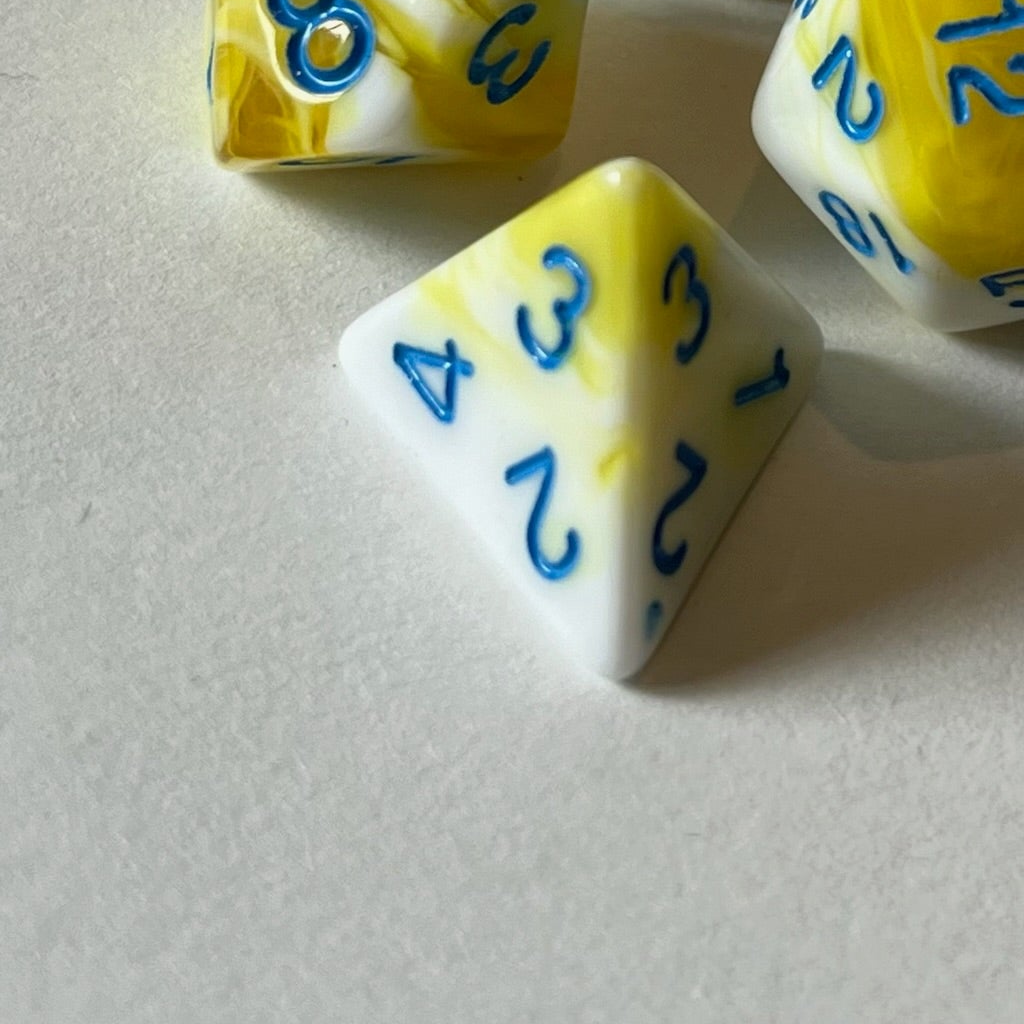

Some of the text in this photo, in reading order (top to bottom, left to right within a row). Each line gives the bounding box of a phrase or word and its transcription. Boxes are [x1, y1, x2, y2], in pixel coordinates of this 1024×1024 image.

[467, 3, 553, 106] 3
[812, 34, 885, 144] 2
[818, 189, 915, 274] 18
[515, 243, 593, 371] 3
[663, 243, 712, 366] 3
[392, 338, 476, 425] 4
[733, 346, 791, 407] 1
[504, 444, 581, 581] 2
[650, 438, 709, 577] 2
